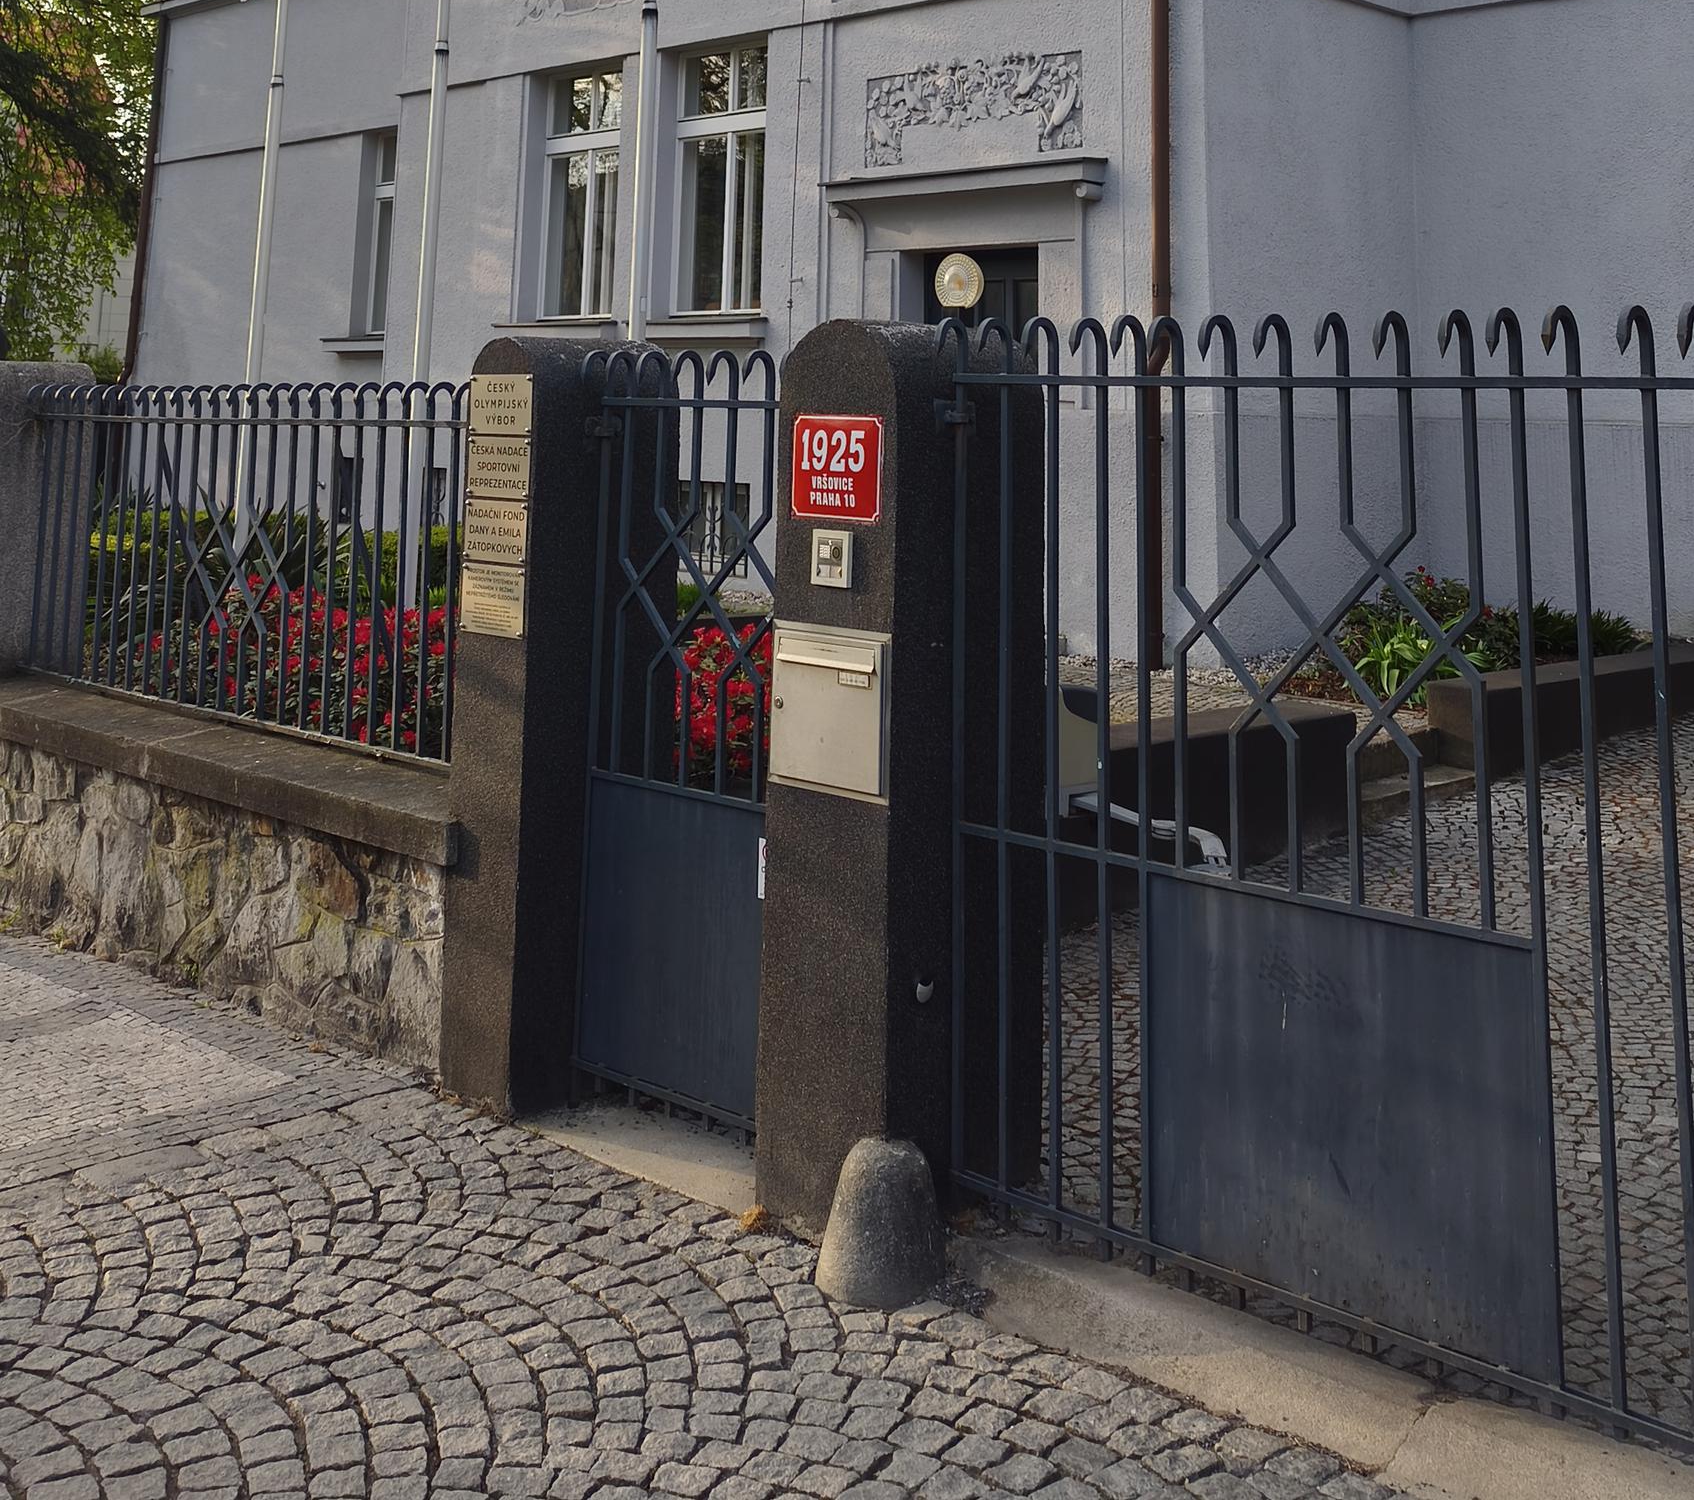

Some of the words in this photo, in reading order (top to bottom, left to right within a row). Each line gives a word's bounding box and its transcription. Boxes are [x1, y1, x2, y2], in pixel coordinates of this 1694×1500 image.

[487, 380, 516, 393] ČESKÝ
[474, 397, 528, 409] OLYMPIJSKÝ
[485, 413, 516, 426] VÝBOR
[496, 446, 528, 457] NADACE
[801, 428, 866, 473] 1925
[477, 461, 520, 473] SPORTOVNÍ
[469, 477, 527, 490] REPREZENTACE
[811, 473, 854, 491] VRŠOVICE
[810, 491, 842, 507] PRAHA
[843, 493, 856, 508] 10
[503, 510, 525, 522] FOND
[469, 524, 490, 535] DANY
[490, 526, 497, 536] A
[498, 527, 522, 538] EMILA
